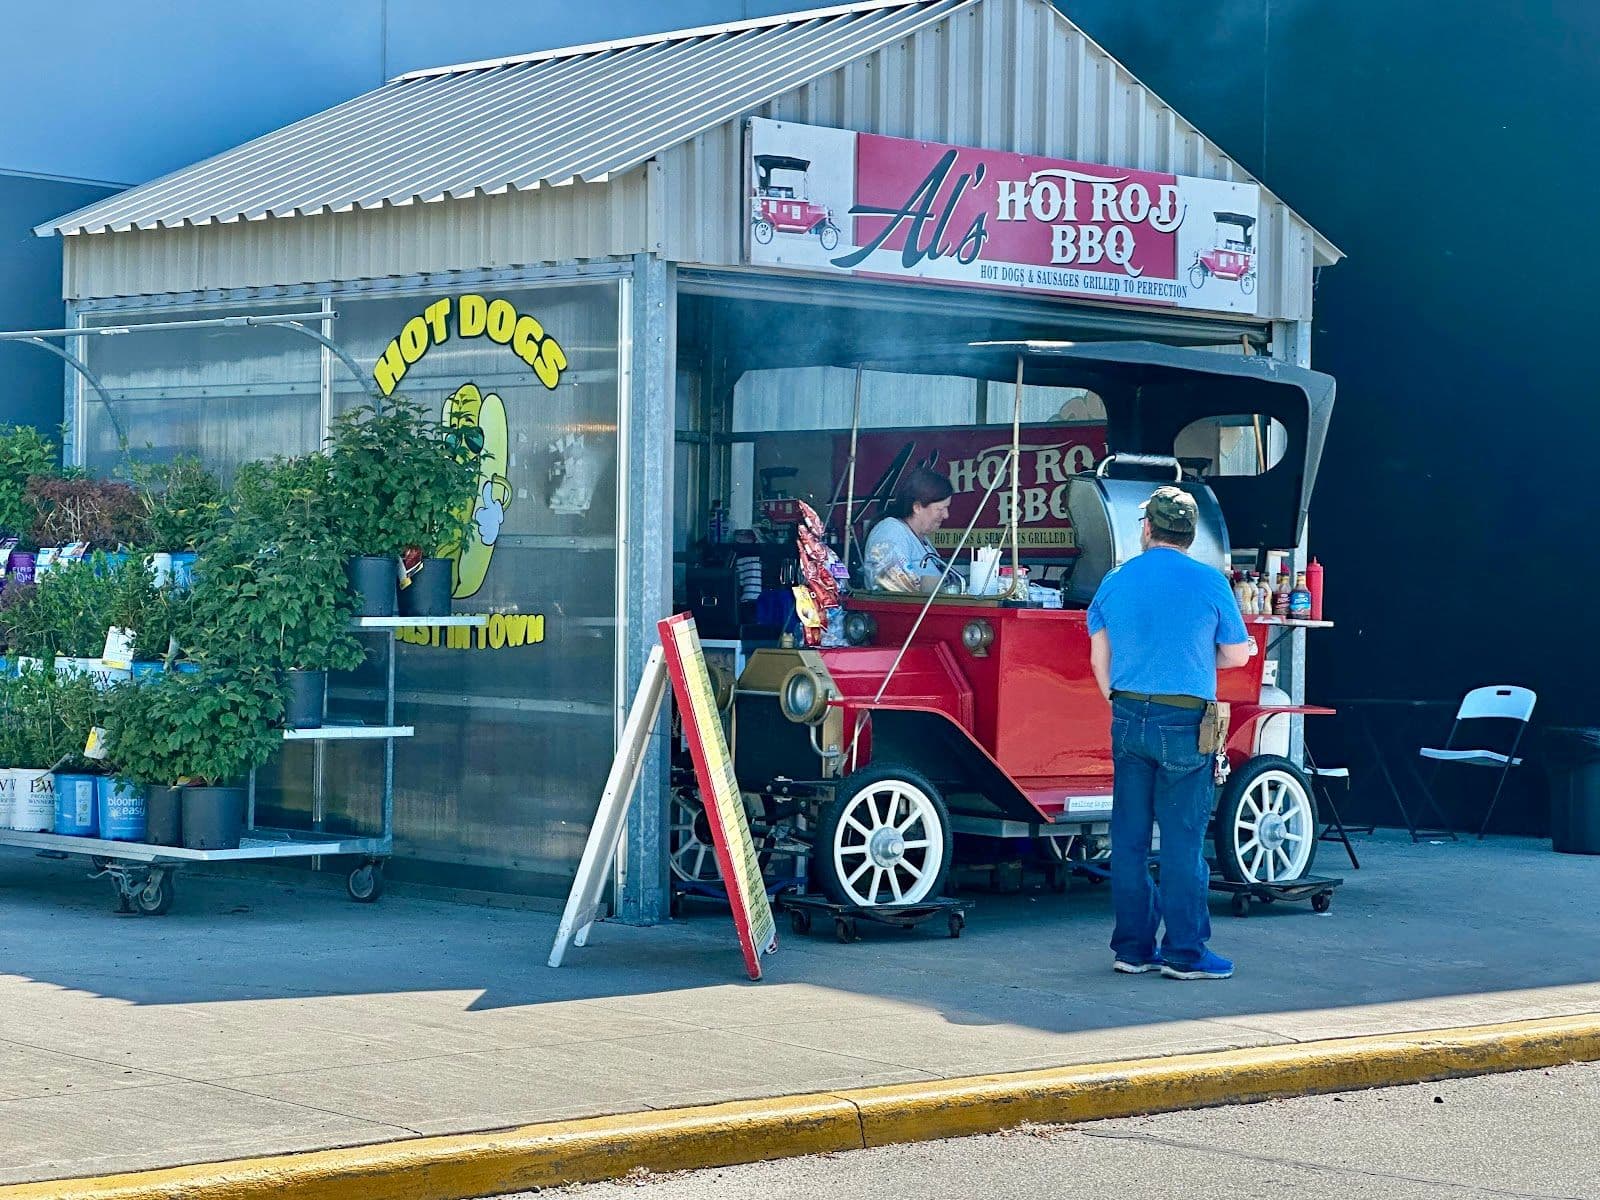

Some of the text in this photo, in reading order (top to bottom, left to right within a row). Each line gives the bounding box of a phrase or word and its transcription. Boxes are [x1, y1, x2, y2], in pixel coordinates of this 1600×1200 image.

[831, 149, 988, 268] Al's
[996, 169, 1187, 232] HOT ROD
[1050, 224, 1145, 278] BBQ
[980, 264, 1188, 298] HOT DOGS & SAUSAGES GRILLED TO PERFECTION
[373, 293, 567, 396] HOT DOGS
[949, 441, 1024, 493] HOT
[934, 532, 950, 545] HOT
[1028, 531, 1066, 545] GRILLED
[446, 613, 471, 650] IN
[474, 612, 545, 650] TOWN
[122, 806, 145, 817] easy
